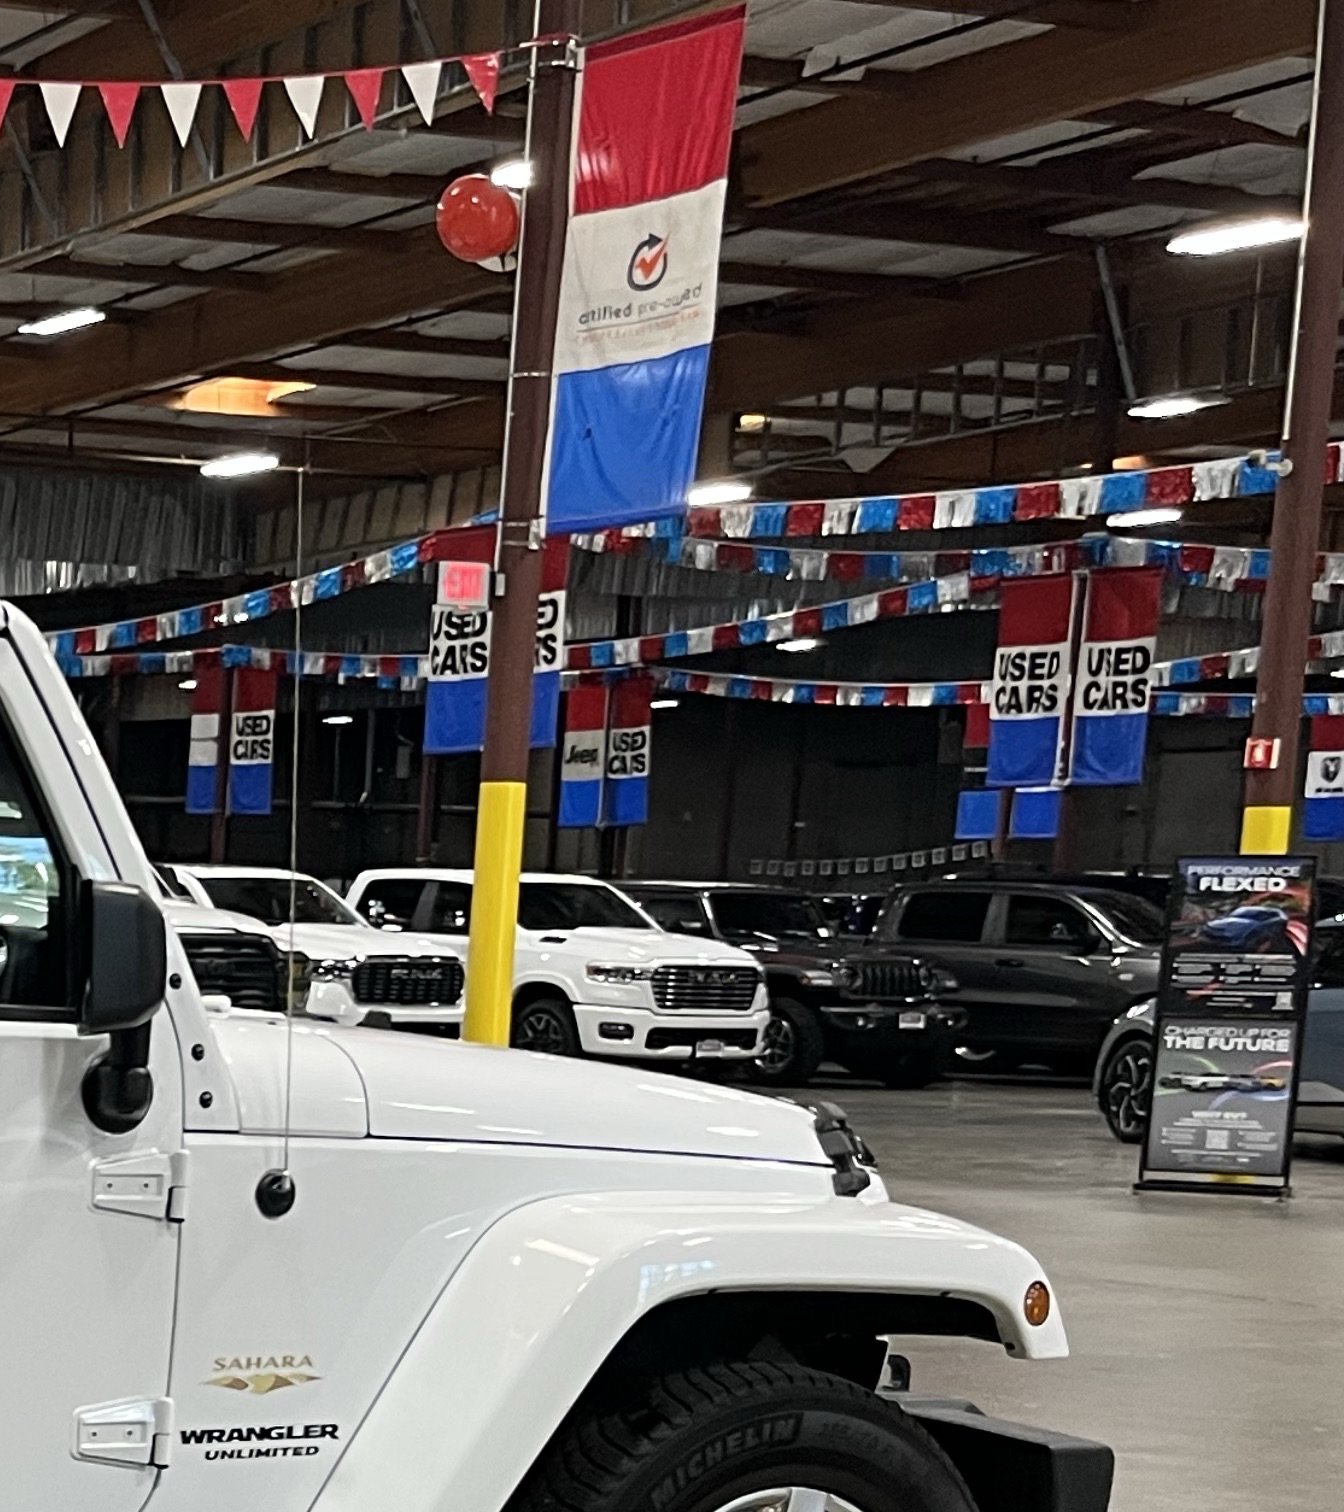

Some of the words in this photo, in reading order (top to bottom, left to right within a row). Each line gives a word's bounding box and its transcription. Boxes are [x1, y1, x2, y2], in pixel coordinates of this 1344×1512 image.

[578, 303, 633, 325] crtified
[997, 650, 1060, 681] USED
[995, 683, 1058, 714] CARS
[1083, 678, 1149, 710] CARS
[235, 714, 272, 737] USED
[608, 752, 647, 775] CAS
[1187, 865, 1301, 878] PERFORMANCE
[1199, 876, 1287, 892] FLEXED
[1164, 1025, 1237, 1037] CHARGED
[1239, 1027, 1259, 1038] UP
[1260, 1028, 1291, 1039] FOR
[1163, 1036, 1205, 1050] THE
[1208, 1037, 1289, 1052] FUTURE
[213, 1354, 314, 1372] SAHARA
[180, 1423, 339, 1444] WRANGLER
[204, 1446, 319, 1461] UNLIMITED
[650, 1416, 799, 1512] MICHELIN
